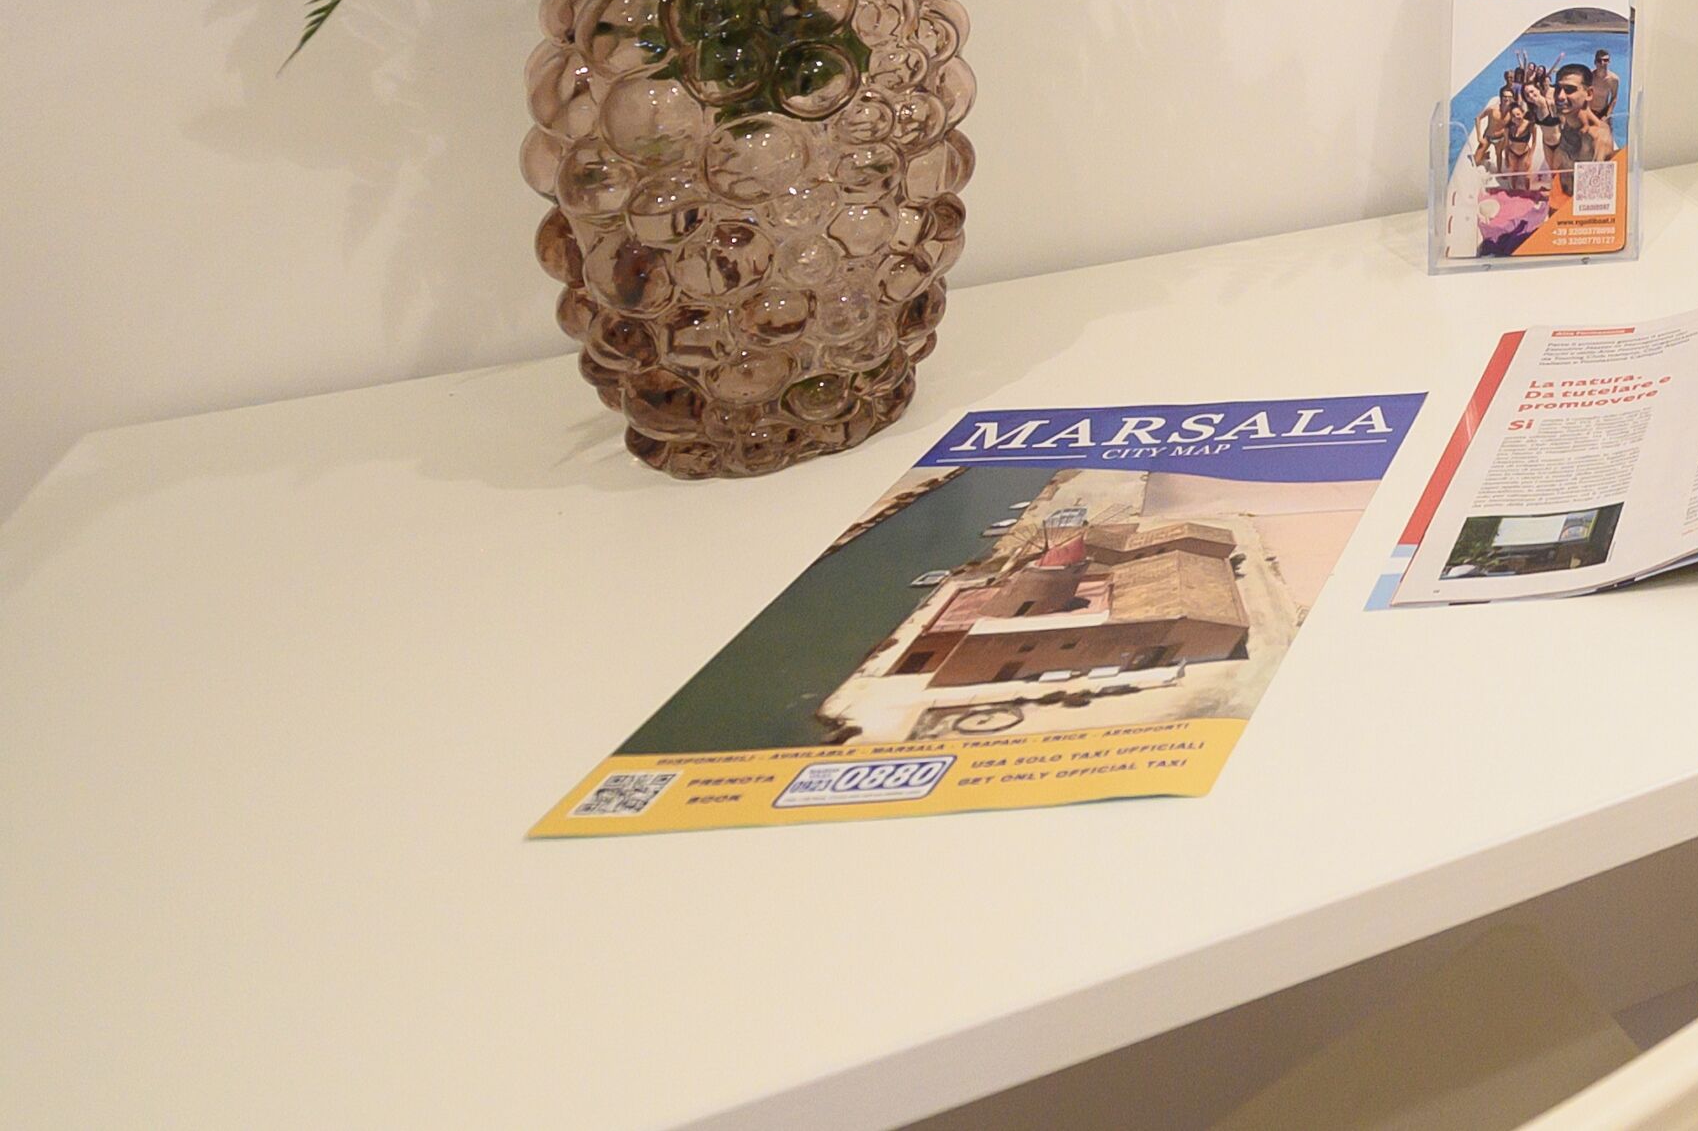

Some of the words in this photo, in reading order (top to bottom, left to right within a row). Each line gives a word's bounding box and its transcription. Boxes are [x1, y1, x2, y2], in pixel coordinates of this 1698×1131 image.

[1524, 390, 1555, 399] Da
[1561, 380, 1654, 398] tutelare
[1658, 375, 1672, 384] e
[1528, 380, 1555, 389] La
[1518, 389, 1659, 413] promuovere
[949, 405, 1394, 452] MARSALA
[1507, 419, 1535, 431] Si
[1101, 447, 1167, 461] CITY
[1169, 443, 1232, 457] MAP
[769, 749, 857, 760] AVAILABLE
[871, 744, 946, 754] MARSALA
[962, 738, 1028, 749] TRAPANI
[1042, 733, 1088, 743] ERICE
[1102, 723, 1190, 738] AEROPORTI
[971, 758, 1007, 769] USA
[1014, 754, 1063, 766] SOLO
[1070, 749, 1111, 761] TAXI
[1116, 741, 1205, 756] UFFICIALI
[687, 775, 776, 787] PRENOTA
[833, 761, 946, 792] 0880
[958, 775, 995, 787] GET
[1001, 771, 1050, 784] ONLY
[1055, 762, 1137, 779] OFFICIAL
[1147, 758, 1188, 768] TAXI
[686, 794, 743, 805] BOOK
